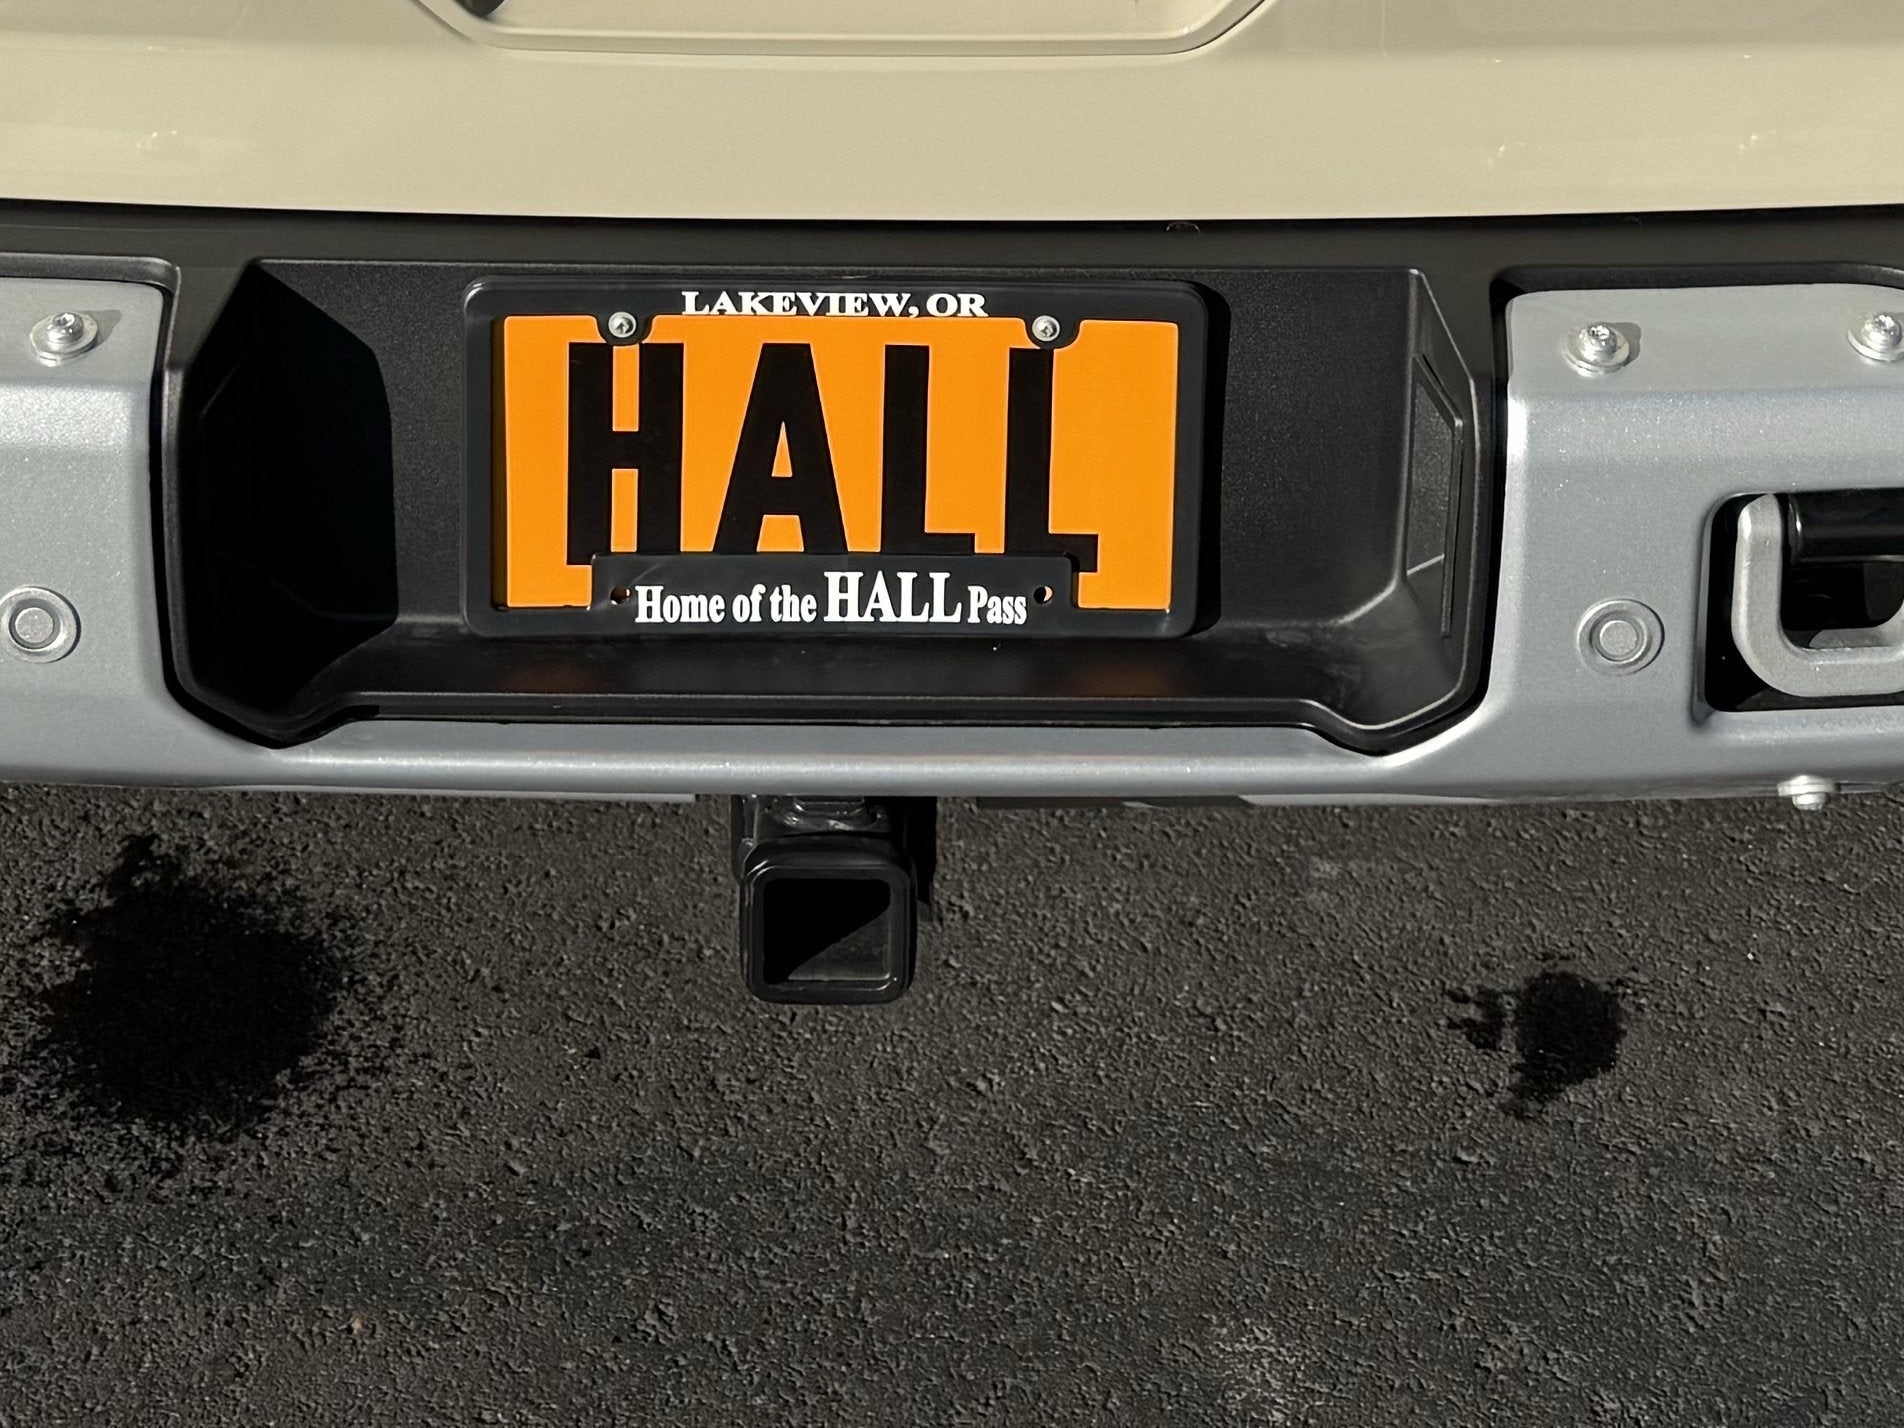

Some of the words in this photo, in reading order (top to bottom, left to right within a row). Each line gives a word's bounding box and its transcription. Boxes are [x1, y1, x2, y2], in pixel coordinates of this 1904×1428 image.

[681, 291, 919, 319] LAKEVIEW,
[926, 292, 989, 318] OR
[566, 341, 1098, 572] HALL
[634, 584, 726, 624] Home
[732, 583, 767, 623] of
[769, 584, 818, 624] the
[823, 570, 963, 624] HALL
[967, 585, 1028, 626] Pass
